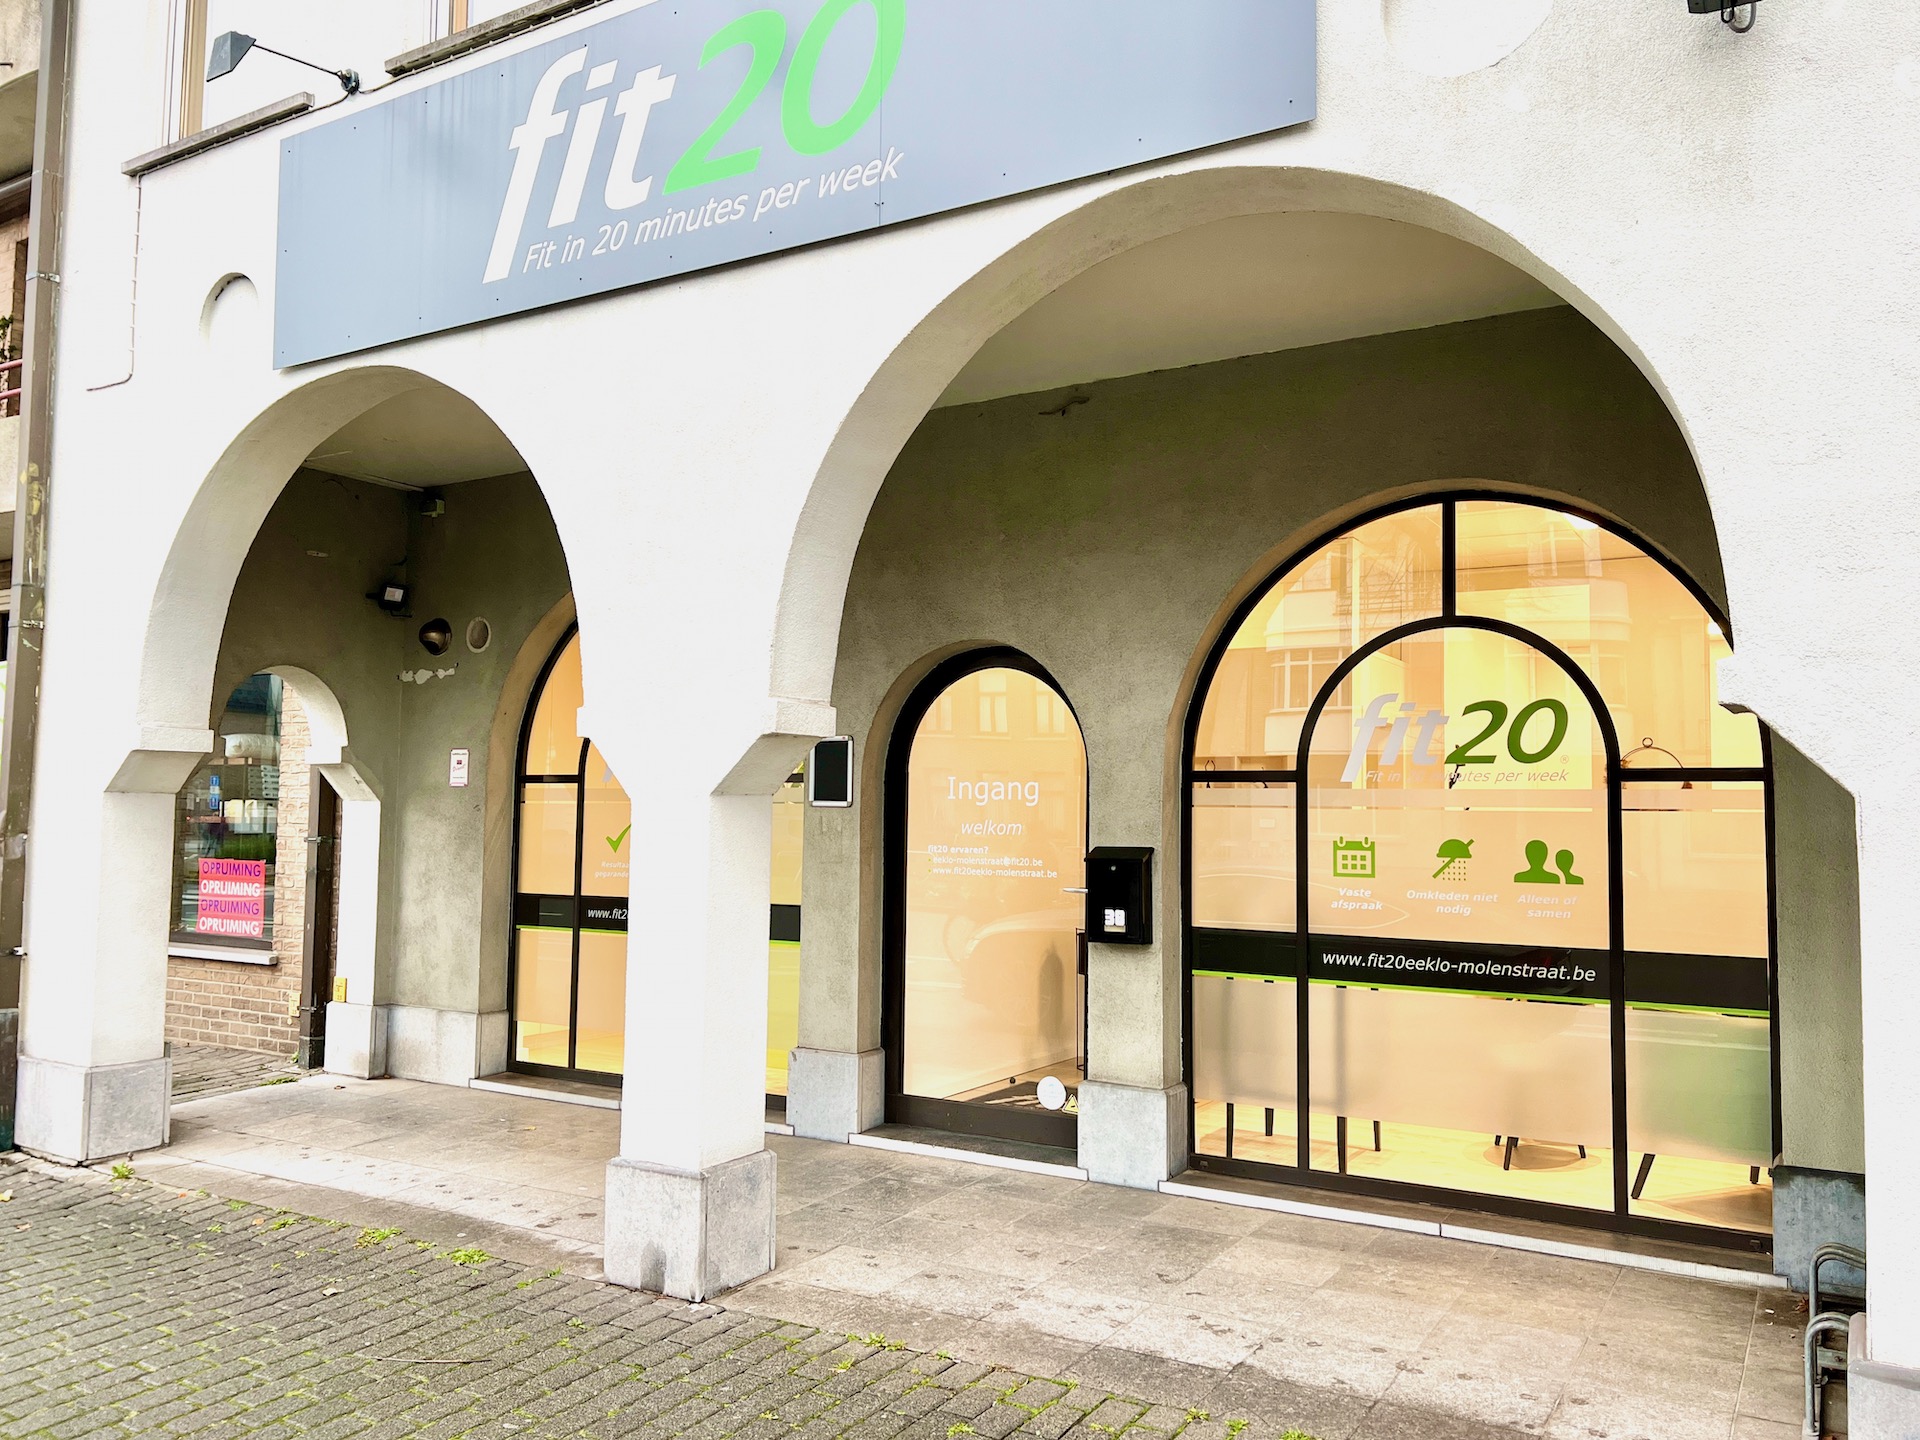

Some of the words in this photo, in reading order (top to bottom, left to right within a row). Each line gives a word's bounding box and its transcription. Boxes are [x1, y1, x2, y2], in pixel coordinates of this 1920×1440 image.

[482, 0, 906, 284] fit20
[522, 242, 556, 274] Fit
[560, 234, 584, 265] in
[592, 220, 628, 256] 20
[633, 196, 748, 247] minutes
[752, 176, 811, 223] per
[817, 146, 906, 199] week
[1340, 693, 1568, 783] fit20
[1366, 770, 1384, 783] Fit
[1494, 771, 1523, 785] per
[1528, 768, 1569, 782] week
[947, 776, 1039, 807] Ingang
[961, 819, 1023, 836] welkom
[927, 844, 948, 854] fit20
[950, 845, 989, 855] ervaren?
[202, 861, 261, 877] OPRUIMING
[201, 879, 261, 897] OPRUIMING
[1339, 887, 1372, 898] Vaste
[1406, 889, 1469, 902] Omkleden
[1473, 891, 1499, 903] niet
[200, 899, 260, 916] OPRUIMING
[1331, 898, 1383, 911] afspraak
[1517, 893, 1559, 906] Alleen
[1562, 895, 1578, 906] of
[587, 908, 629, 920] www.fit2
[1104, 908, 1126, 927] 38
[1436, 903, 1472, 917] nodig
[1527, 908, 1572, 919] samen
[199, 916, 260, 936] OPRUIMING
[1322, 952, 1596, 982] www.fit20eeklo-molenstraat.be
